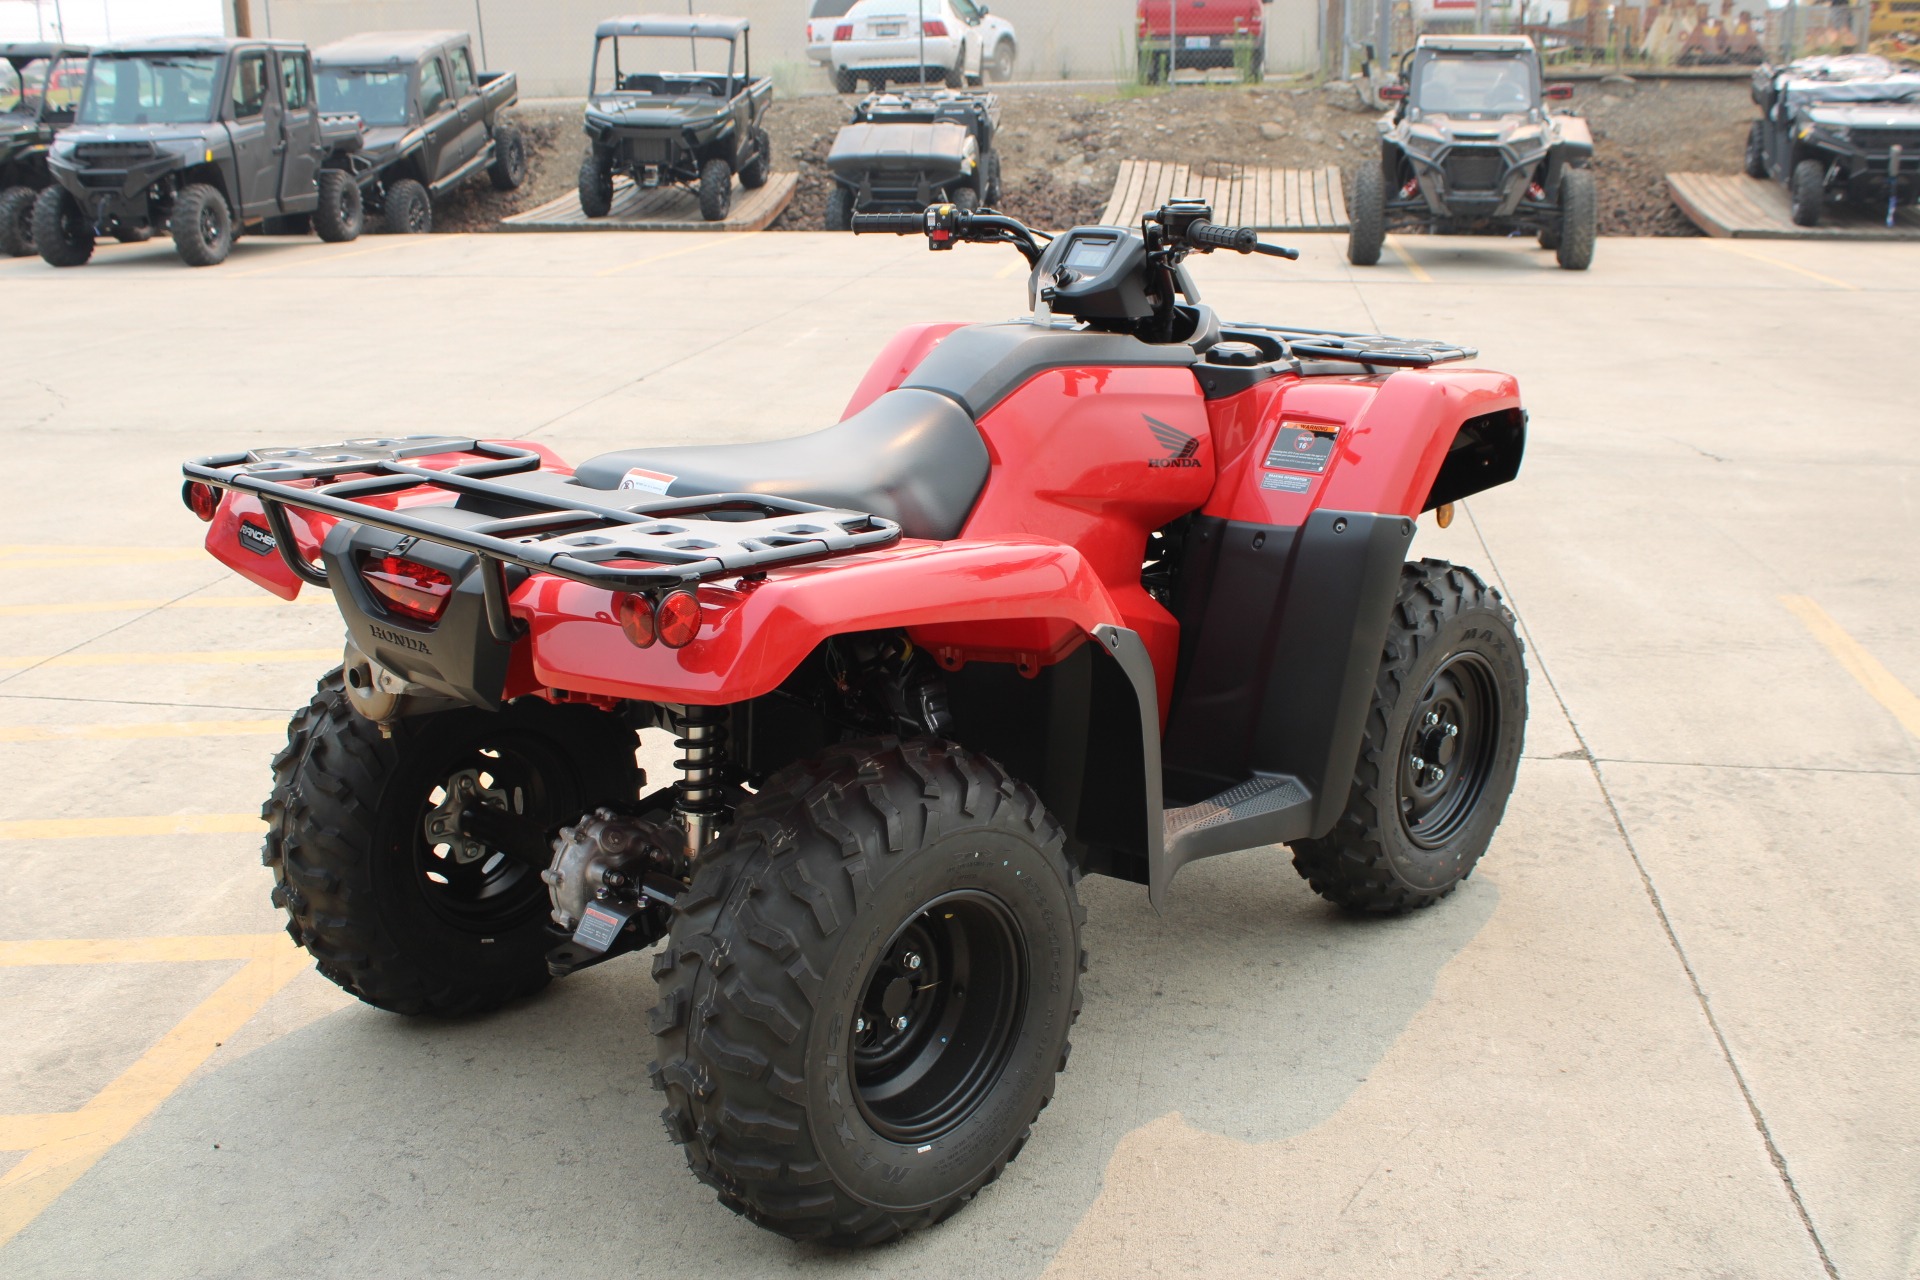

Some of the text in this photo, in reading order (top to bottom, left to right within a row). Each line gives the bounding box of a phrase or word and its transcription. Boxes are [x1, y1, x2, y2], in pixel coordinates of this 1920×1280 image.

[1300, 424, 1329, 432] WARNING
[1147, 458, 1202, 468] HONDA
[239, 524, 277, 548] RANCHER
[368, 623, 433, 655] HONDA
[1459, 627, 1520, 710] MAXXIS
[825, 1010, 913, 1185] MAXXIS
